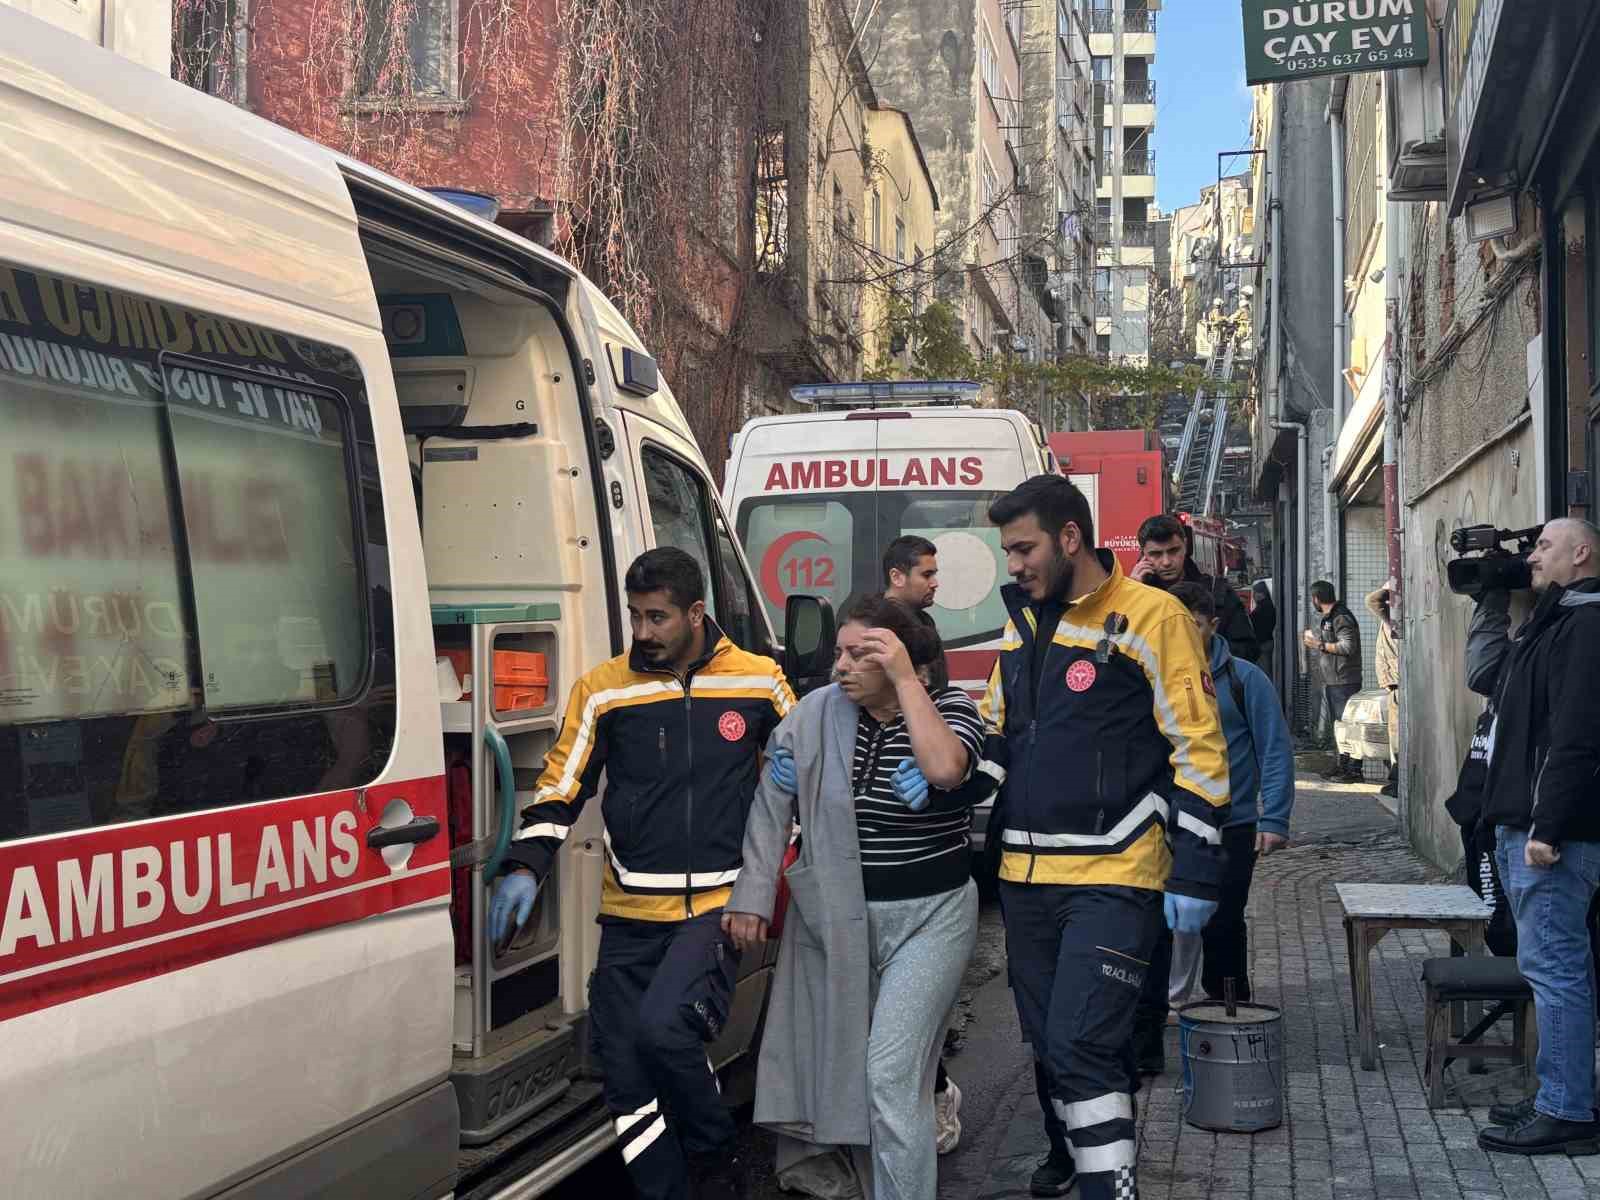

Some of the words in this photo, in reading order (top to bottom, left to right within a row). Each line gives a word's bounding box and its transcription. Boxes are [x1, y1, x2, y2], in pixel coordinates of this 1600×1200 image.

[1263, 30, 1338, 65] ÇAY
[1351, 17, 1413, 50] EVİ
[1287, 56, 1328, 71] 0535
[1332, 52, 1361, 66] 637
[1367, 49, 1388, 62] 65
[515, 399, 525, 410] G
[763, 456, 984, 491] AMBULANS
[784, 557, 834, 588] 112
[0, 810, 360, 957] AMBULANS
